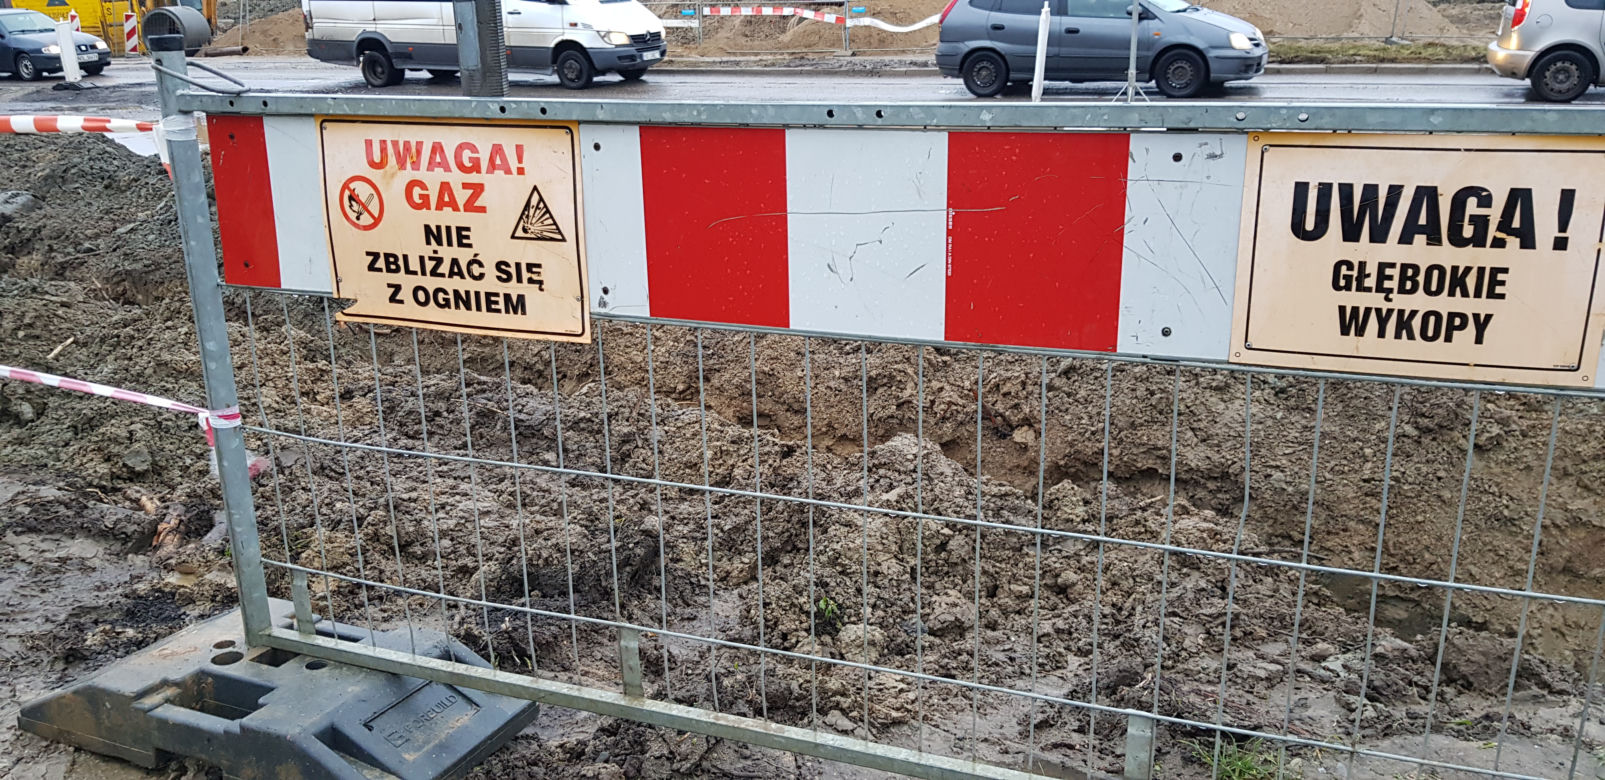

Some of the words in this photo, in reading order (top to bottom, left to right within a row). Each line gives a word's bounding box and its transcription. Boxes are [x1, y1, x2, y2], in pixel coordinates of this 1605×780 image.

[364, 139, 526, 176] UWAGA!
[404, 179, 488, 214] GAZ
[423, 223, 474, 249] NIE
[365, 249, 486, 282] ZBLIŻAĆ
[494, 260, 545, 292] SIĘ
[1331, 259, 1510, 303] GŁĘBOKIE
[386, 282, 405, 305] Z
[411, 285, 527, 316] OGNIEM
[1337, 304, 1494, 345] WYKOPY
